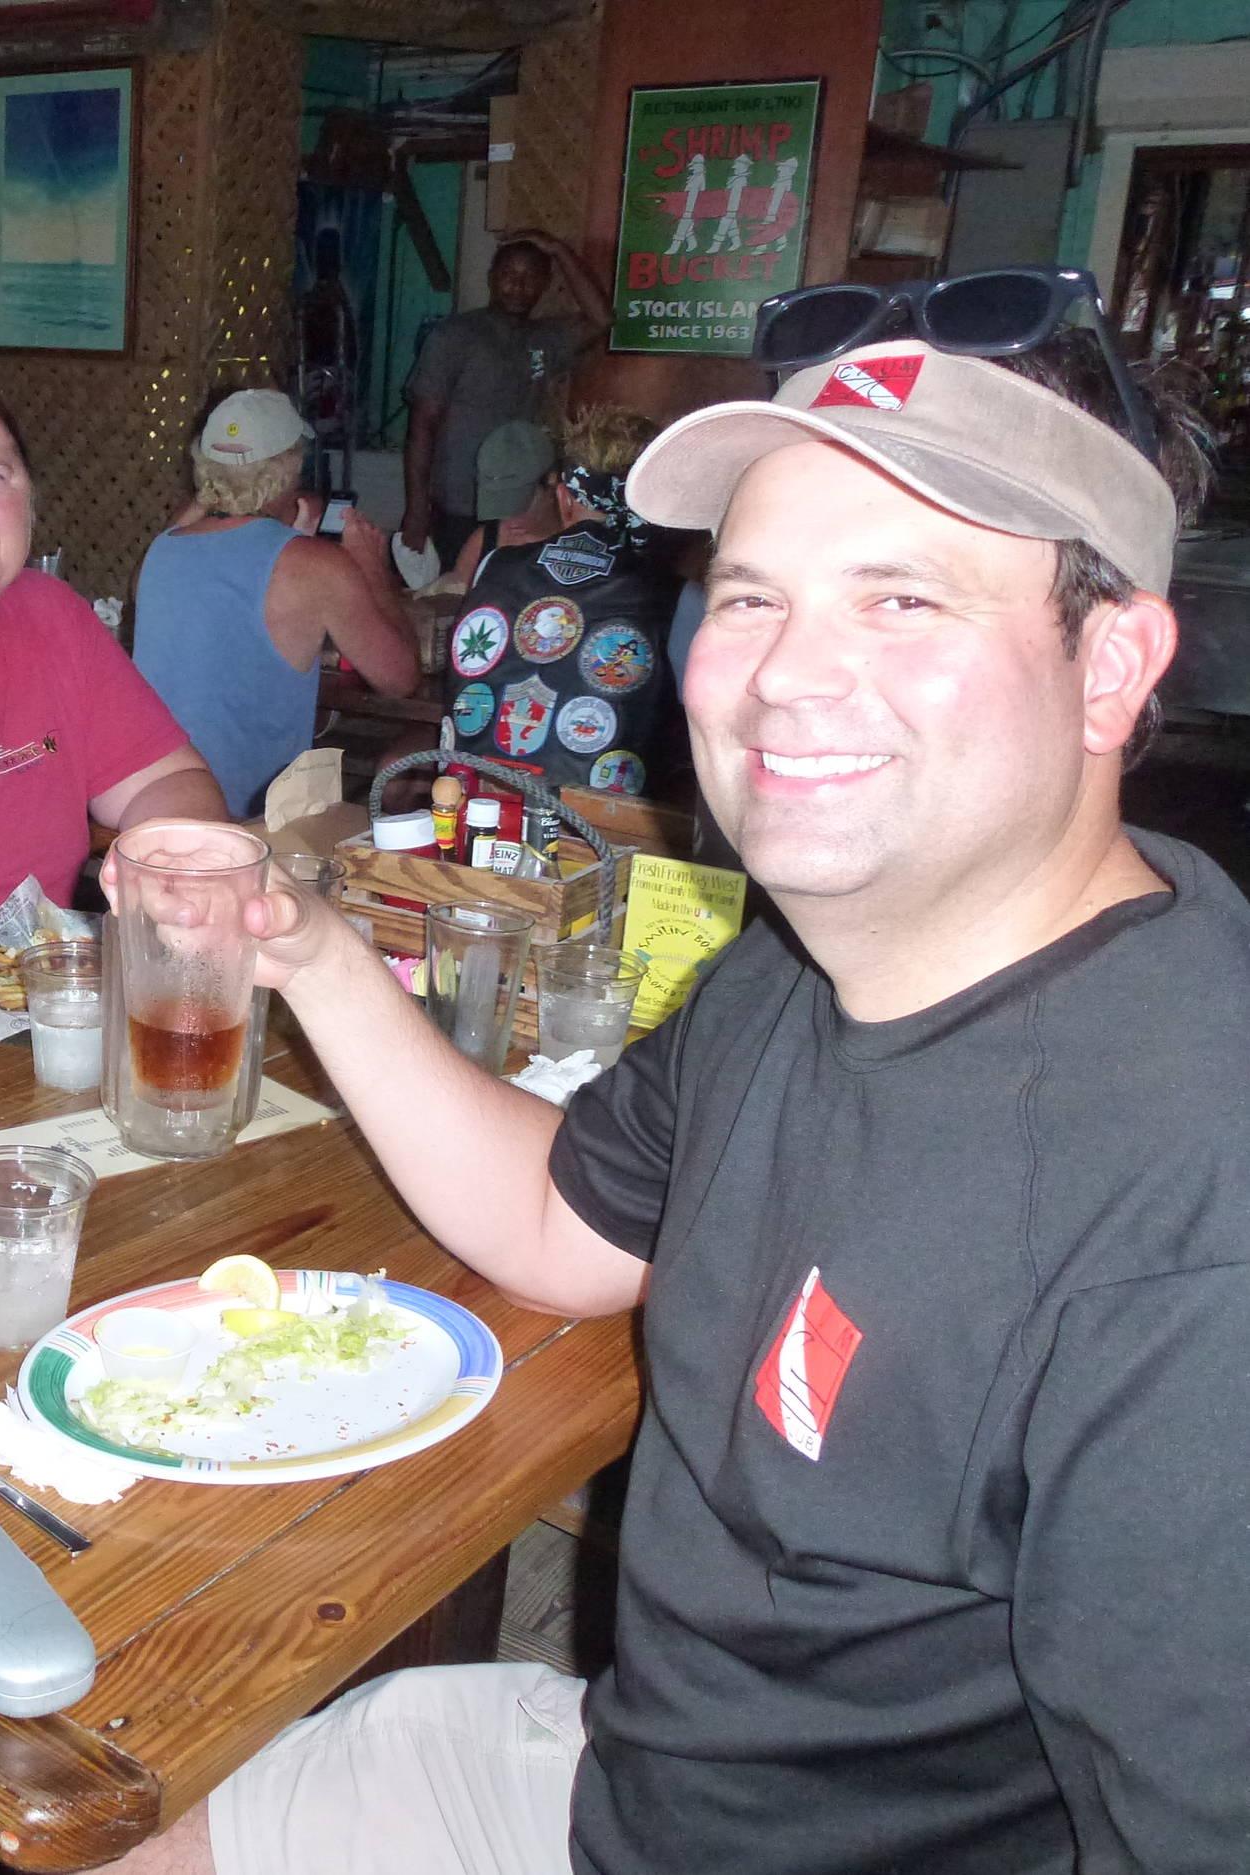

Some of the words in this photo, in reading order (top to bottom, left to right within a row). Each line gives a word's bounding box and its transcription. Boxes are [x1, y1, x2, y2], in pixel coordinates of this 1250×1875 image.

[655, 122, 793, 178] SHRIMP
[628, 252, 783, 290] BUCKET
[628, 300, 691, 318] STOCK
[696, 300, 759, 319] ISLAN
[648, 325, 703, 339] SINCE
[706, 325, 751, 340] 1963
[494, 850, 519, 861] EINZ
[694, 908, 713, 919] UA
